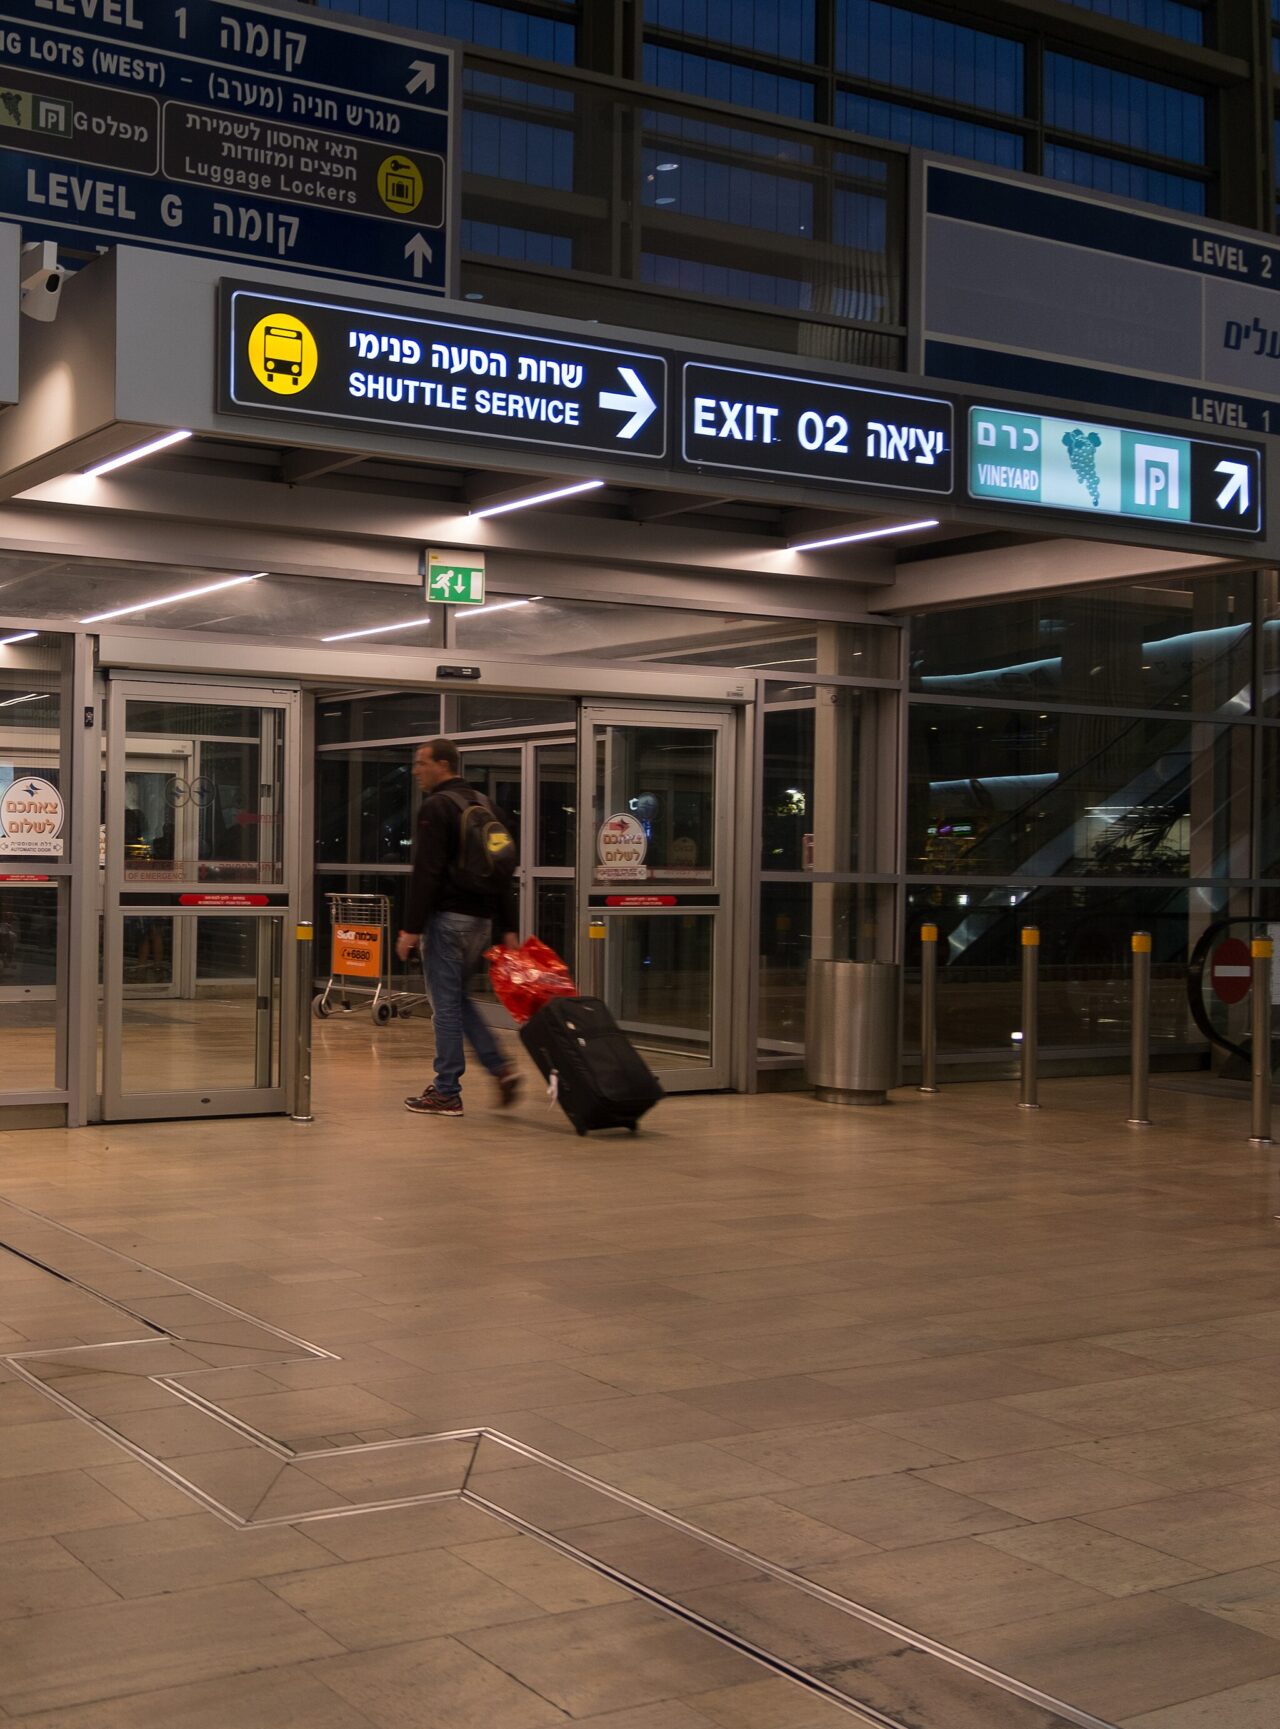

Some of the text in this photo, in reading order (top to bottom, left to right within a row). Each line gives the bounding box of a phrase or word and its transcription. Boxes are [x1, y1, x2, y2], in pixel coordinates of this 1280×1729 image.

[175, 7, 187, 39] 1
[220, 16, 307, 72] קומה
[30, 36, 85, 68] LOTS
[92, 48, 166, 88] (WEST)
[208, 72, 401, 134] מגרש חניה (מערב)
[73, 111, 148, 143] מפלס G
[186, 113, 358, 161] תאי אחסון לשמירת
[185, 157, 357, 204] Luggage Lockers
[222, 143, 358, 181] חפצים ומזוודות
[26, 168, 183, 228] LEVEL G
[213, 202, 300, 255] קומה
[1192, 238, 1272, 279] LEVEL 2
[349, 331, 584, 389] שרות הסעה פנימי
[349, 371, 580, 426] SHUTTLE SERVICE
[1191, 396, 1271, 433] LEVEL 1
[693, 397, 849, 454] EXIT 02
[866, 422, 945, 465] יציאה
[977, 421, 1040, 452] כרם
[977, 463, 1039, 491] VINEYARD
[6, 800, 59, 815] צאתכם
[8, 819, 56, 835] לשלום
[605, 848, 641, 862] לשלום
[140, 872, 186, 881] EMERGENCY
